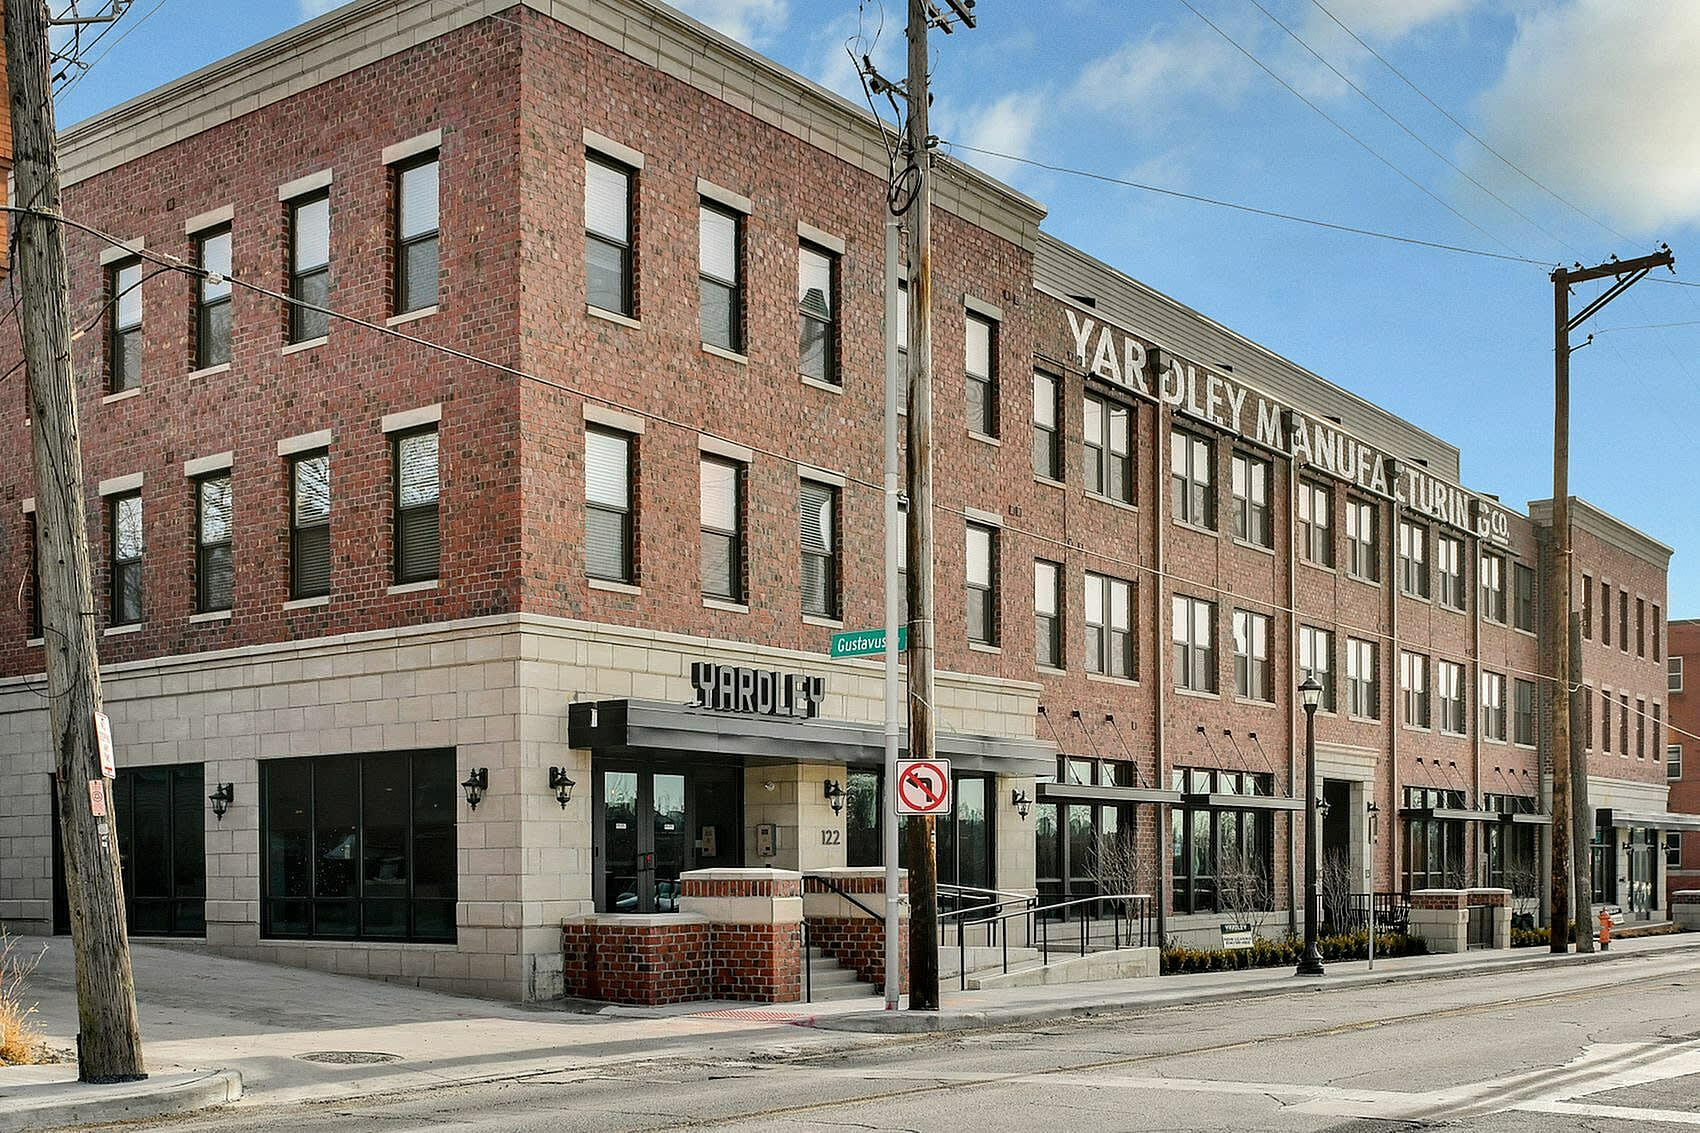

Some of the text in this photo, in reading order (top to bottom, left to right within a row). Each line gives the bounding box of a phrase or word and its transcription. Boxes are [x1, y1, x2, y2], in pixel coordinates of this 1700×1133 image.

[837, 636, 887, 653] Gustavus
[692, 661, 826, 719] YARDLEY
[821, 829, 841, 845] 122
